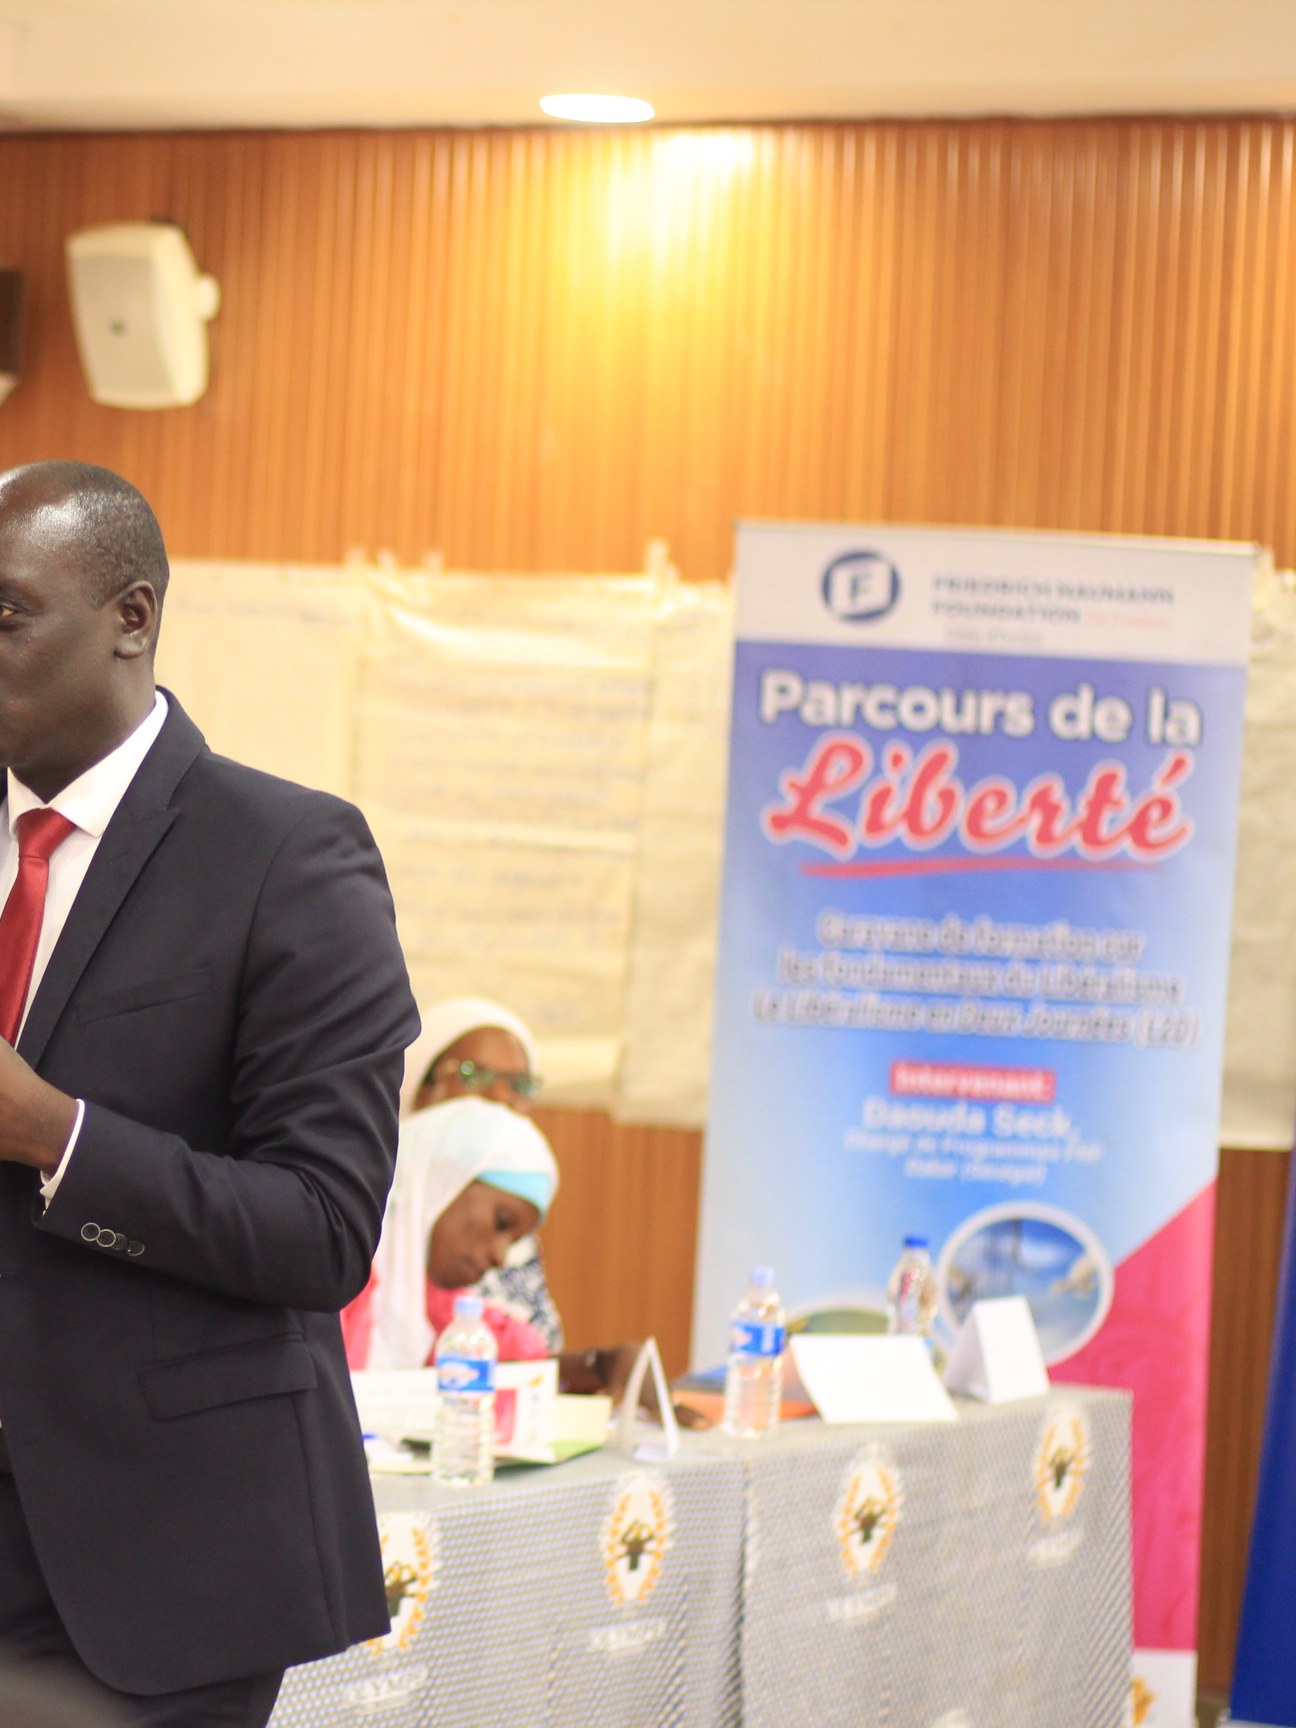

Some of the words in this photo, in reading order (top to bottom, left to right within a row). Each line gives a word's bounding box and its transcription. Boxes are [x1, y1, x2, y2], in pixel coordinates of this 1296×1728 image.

[932, 600, 1081, 624] FOUNDATION
[761, 669, 1035, 738] Parcours
[1050, 683, 1132, 742] de
[1148, 688, 1201, 746] la
[764, 736, 1192, 861] Liberté
